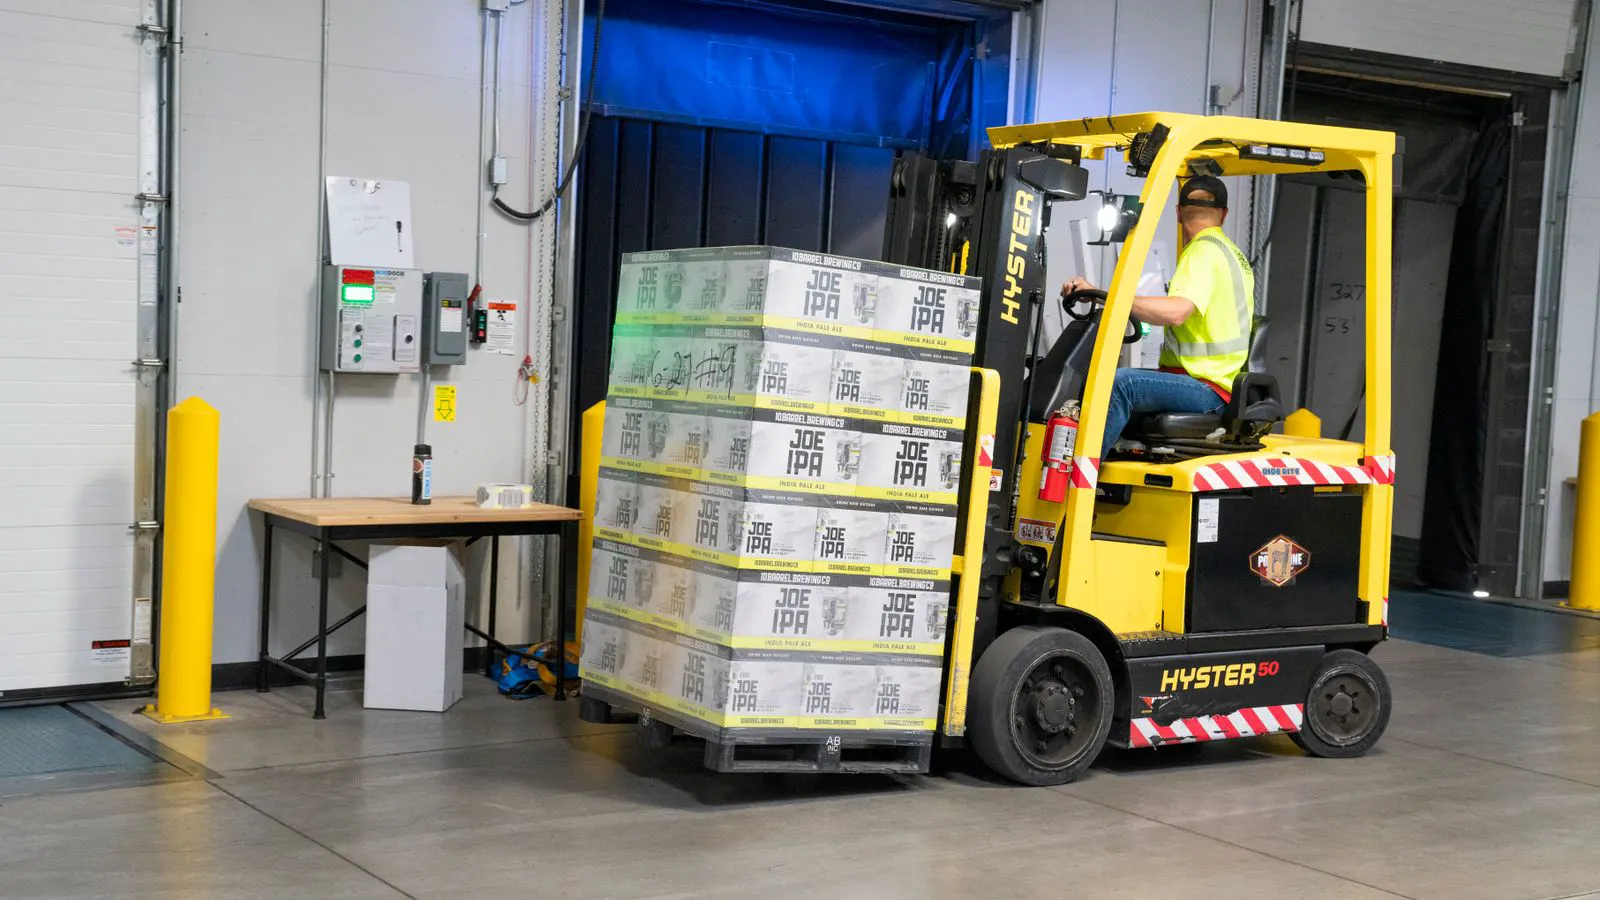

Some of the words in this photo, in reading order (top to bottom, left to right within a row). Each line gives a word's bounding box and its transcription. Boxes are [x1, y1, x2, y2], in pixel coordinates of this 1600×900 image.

[1000, 190, 1034, 325] HYSTER
[806, 270, 842, 293] JOE
[804, 292, 840, 320] IPA
[913, 286, 947, 308] JOE
[910, 306, 944, 334] IPA
[935, 338, 946, 346] ALE
[764, 360, 788, 377] JOE
[838, 368, 862, 384] JOE
[762, 376, 787, 395] IPA
[836, 383, 860, 402] IPA
[907, 378, 930, 393] JOE
[905, 392, 929, 410] IPA
[622, 412, 642, 432] JOE
[620, 432, 640, 456] IPA
[686, 432, 702, 448] JOE
[730, 438, 748, 452] JOE
[790, 428, 825, 451] JOE
[684, 447, 700, 464] IPA
[896, 440, 930, 462] JOE
[728, 452, 746, 472] IPA
[786, 450, 824, 477] IPA
[893, 460, 928, 487] IPA
[778, 480, 796, 488] INDIA
[814, 482, 825, 490] ALE
[886, 490, 902, 498] INDIA
[918, 492, 930, 500] ALE
[657, 506, 672, 520] JOE
[698, 499, 720, 521] JOE
[655, 519, 670, 537] IPA
[695, 520, 718, 547] IPA
[748, 522, 773, 536] JOE
[822, 527, 846, 541] JOE
[746, 536, 770, 554] IPA
[892, 532, 916, 545] JOE
[820, 540, 844, 559] IPA
[891, 544, 914, 562] IPA
[609, 556, 628, 578] JOE
[608, 575, 627, 602] IPA
[775, 588, 812, 609] JOE
[883, 592, 917, 614] JOE
[772, 608, 809, 635] IPA
[880, 612, 914, 638] IPA
[684, 652, 706, 676] JOE
[1160, 662, 1257, 692] HYSTER
[1258, 661, 1279, 677] 50
[682, 672, 704, 704] IPA
[734, 680, 758, 694] JOE
[808, 682, 832, 696] JOE
[878, 684, 901, 697] JOE
[732, 694, 757, 712] IPA
[806, 696, 830, 714] IPA
[876, 698, 900, 714] IPA
[826, 736, 840, 746] AB
